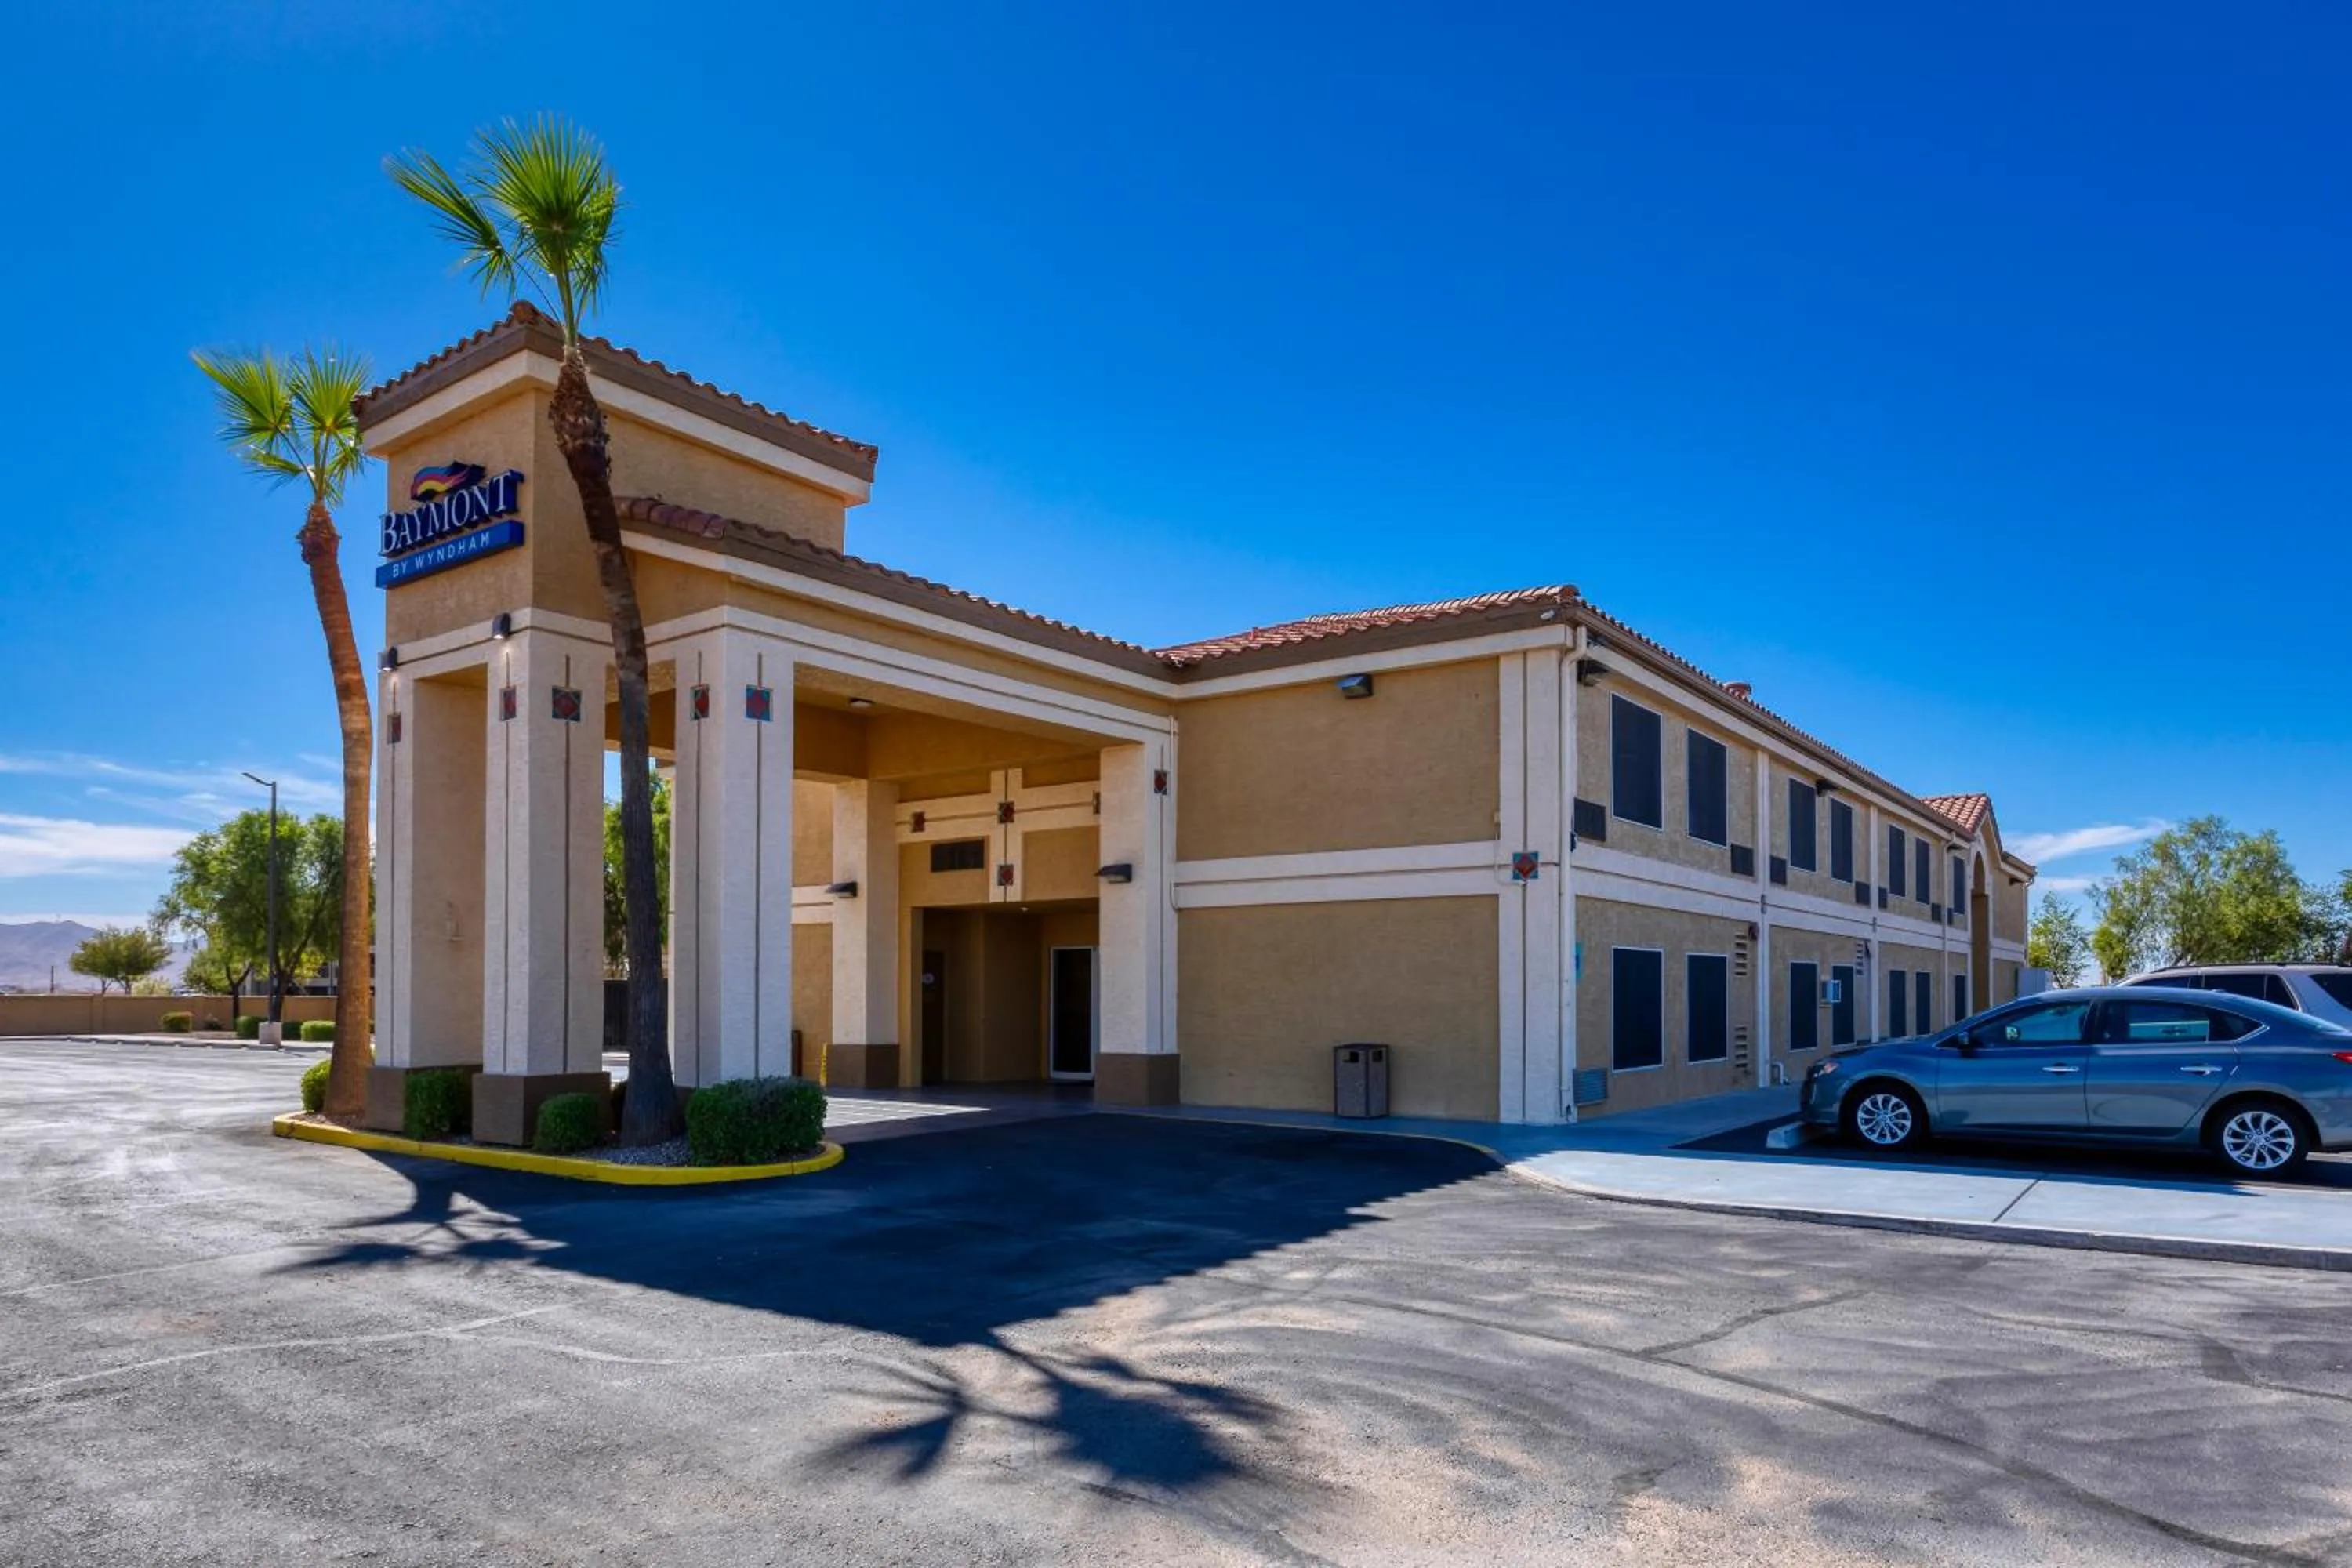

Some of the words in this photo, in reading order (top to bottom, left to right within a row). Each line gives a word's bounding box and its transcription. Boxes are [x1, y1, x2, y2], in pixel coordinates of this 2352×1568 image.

[378, 470, 518, 557] BAYMONT
[391, 561, 408, 579] BY
[414, 531, 490, 569] WYNDHAM
